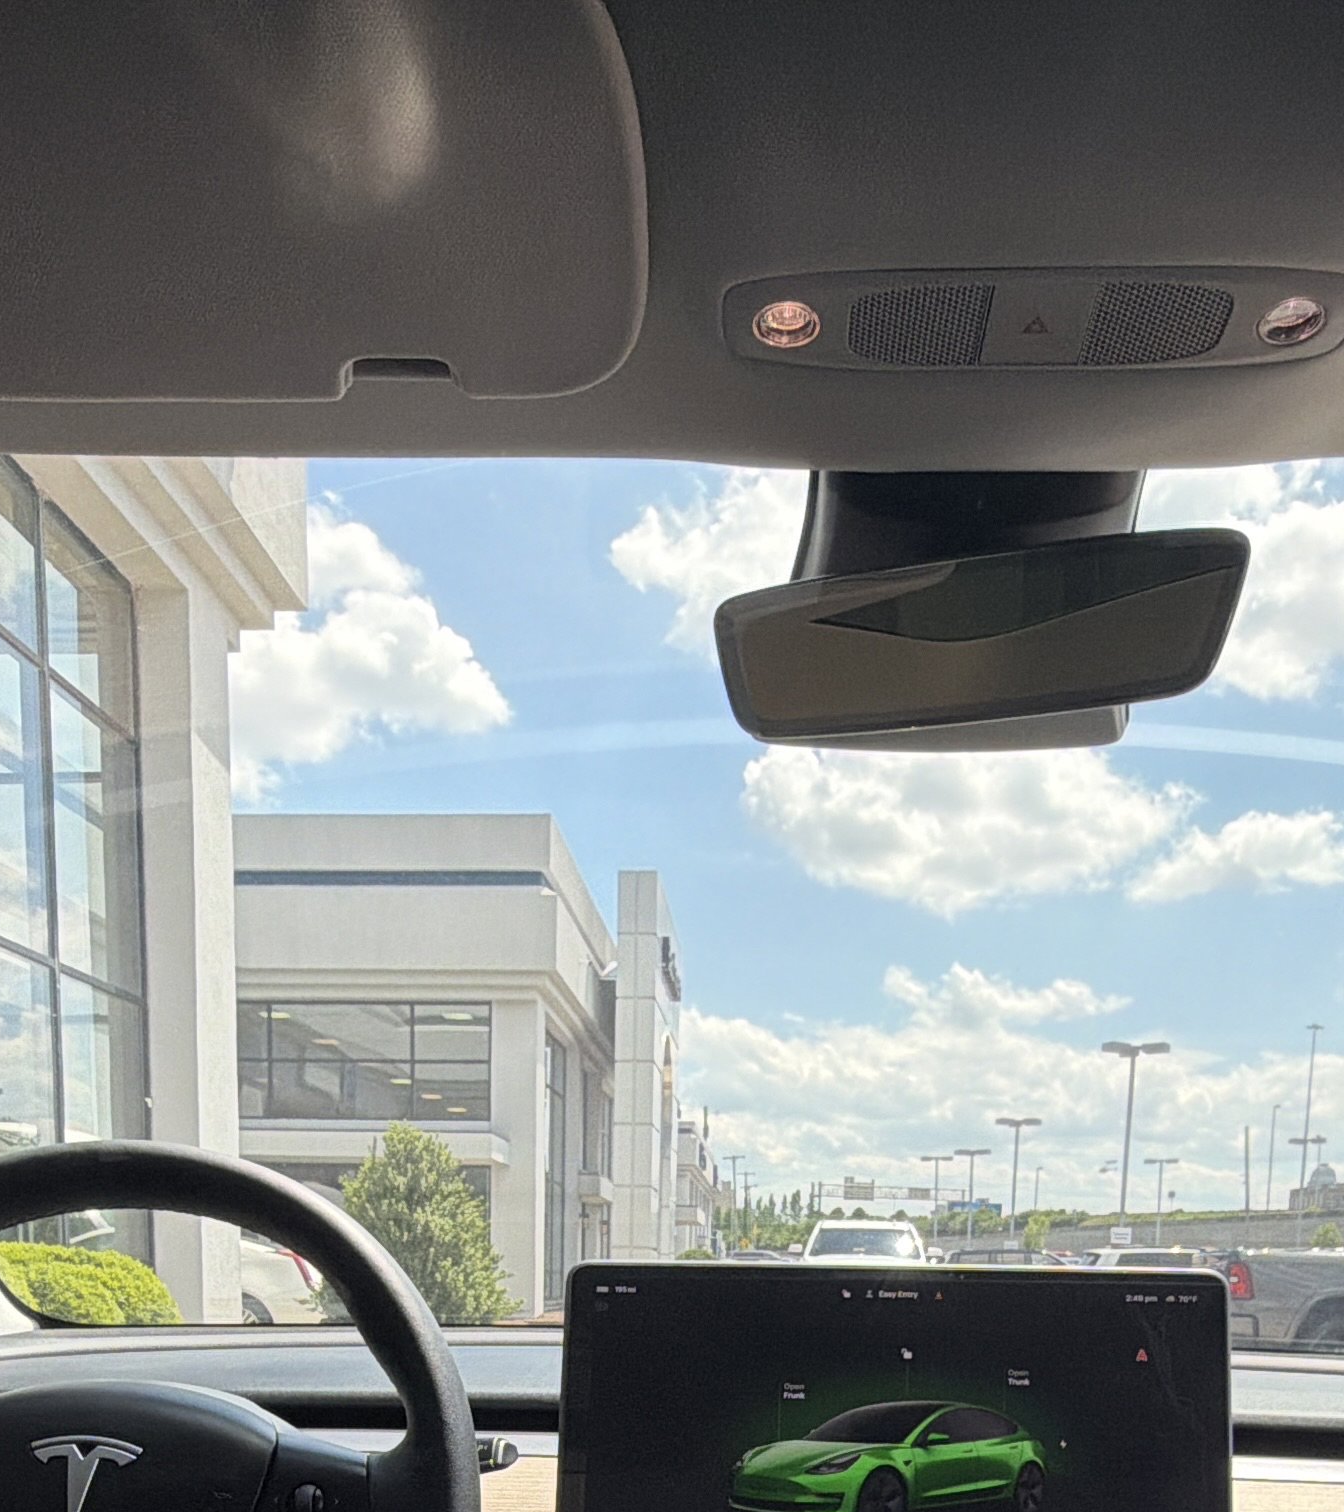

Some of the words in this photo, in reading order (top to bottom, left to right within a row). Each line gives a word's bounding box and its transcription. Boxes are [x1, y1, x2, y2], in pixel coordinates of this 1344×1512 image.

[878, 1290, 896, 1299] Easy
[897, 1291, 919, 1299] Entry
[1145, 1295, 1158, 1304] pm
[1008, 1369, 1030, 1378] Open
[783, 1382, 805, 1391] Open
[1008, 1378, 1030, 1386] Trunk
[783, 1391, 805, 1400] Frunk
